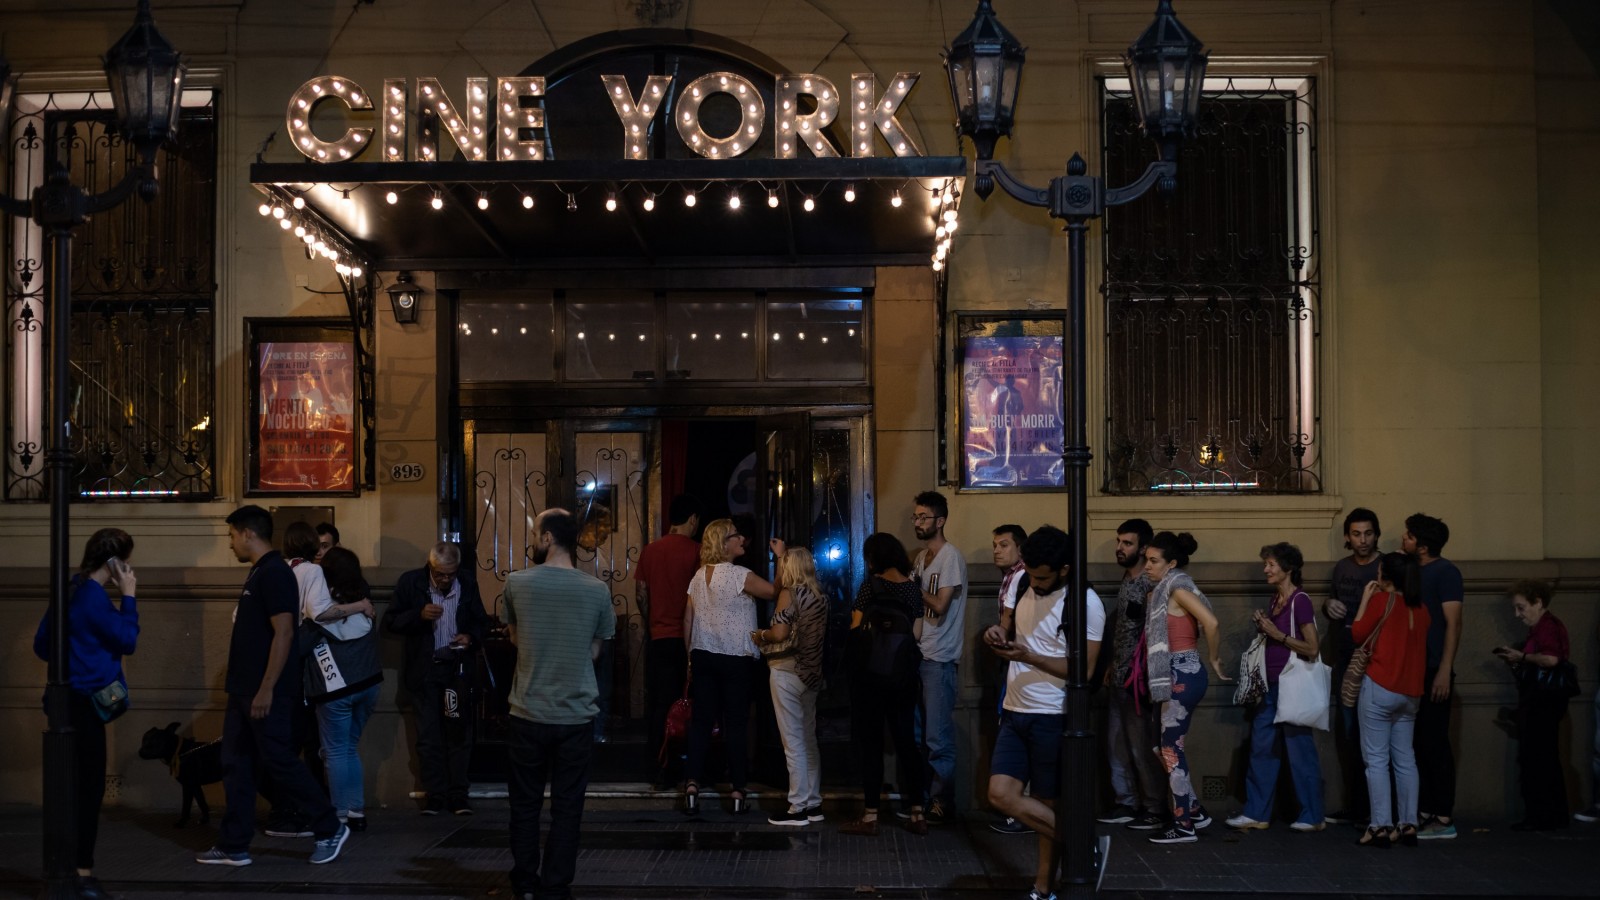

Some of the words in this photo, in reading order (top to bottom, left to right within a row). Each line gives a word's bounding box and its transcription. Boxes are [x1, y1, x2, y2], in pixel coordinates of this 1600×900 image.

[286, 75, 546, 162] CINE
[600, 71, 922, 160] YORK
[294, 352, 307, 360] EN
[991, 415, 1016, 429] BUEN
[1021, 414, 1055, 428] MORIR
[393, 465, 421, 478] 895
[316, 642, 337, 681] GUESS
